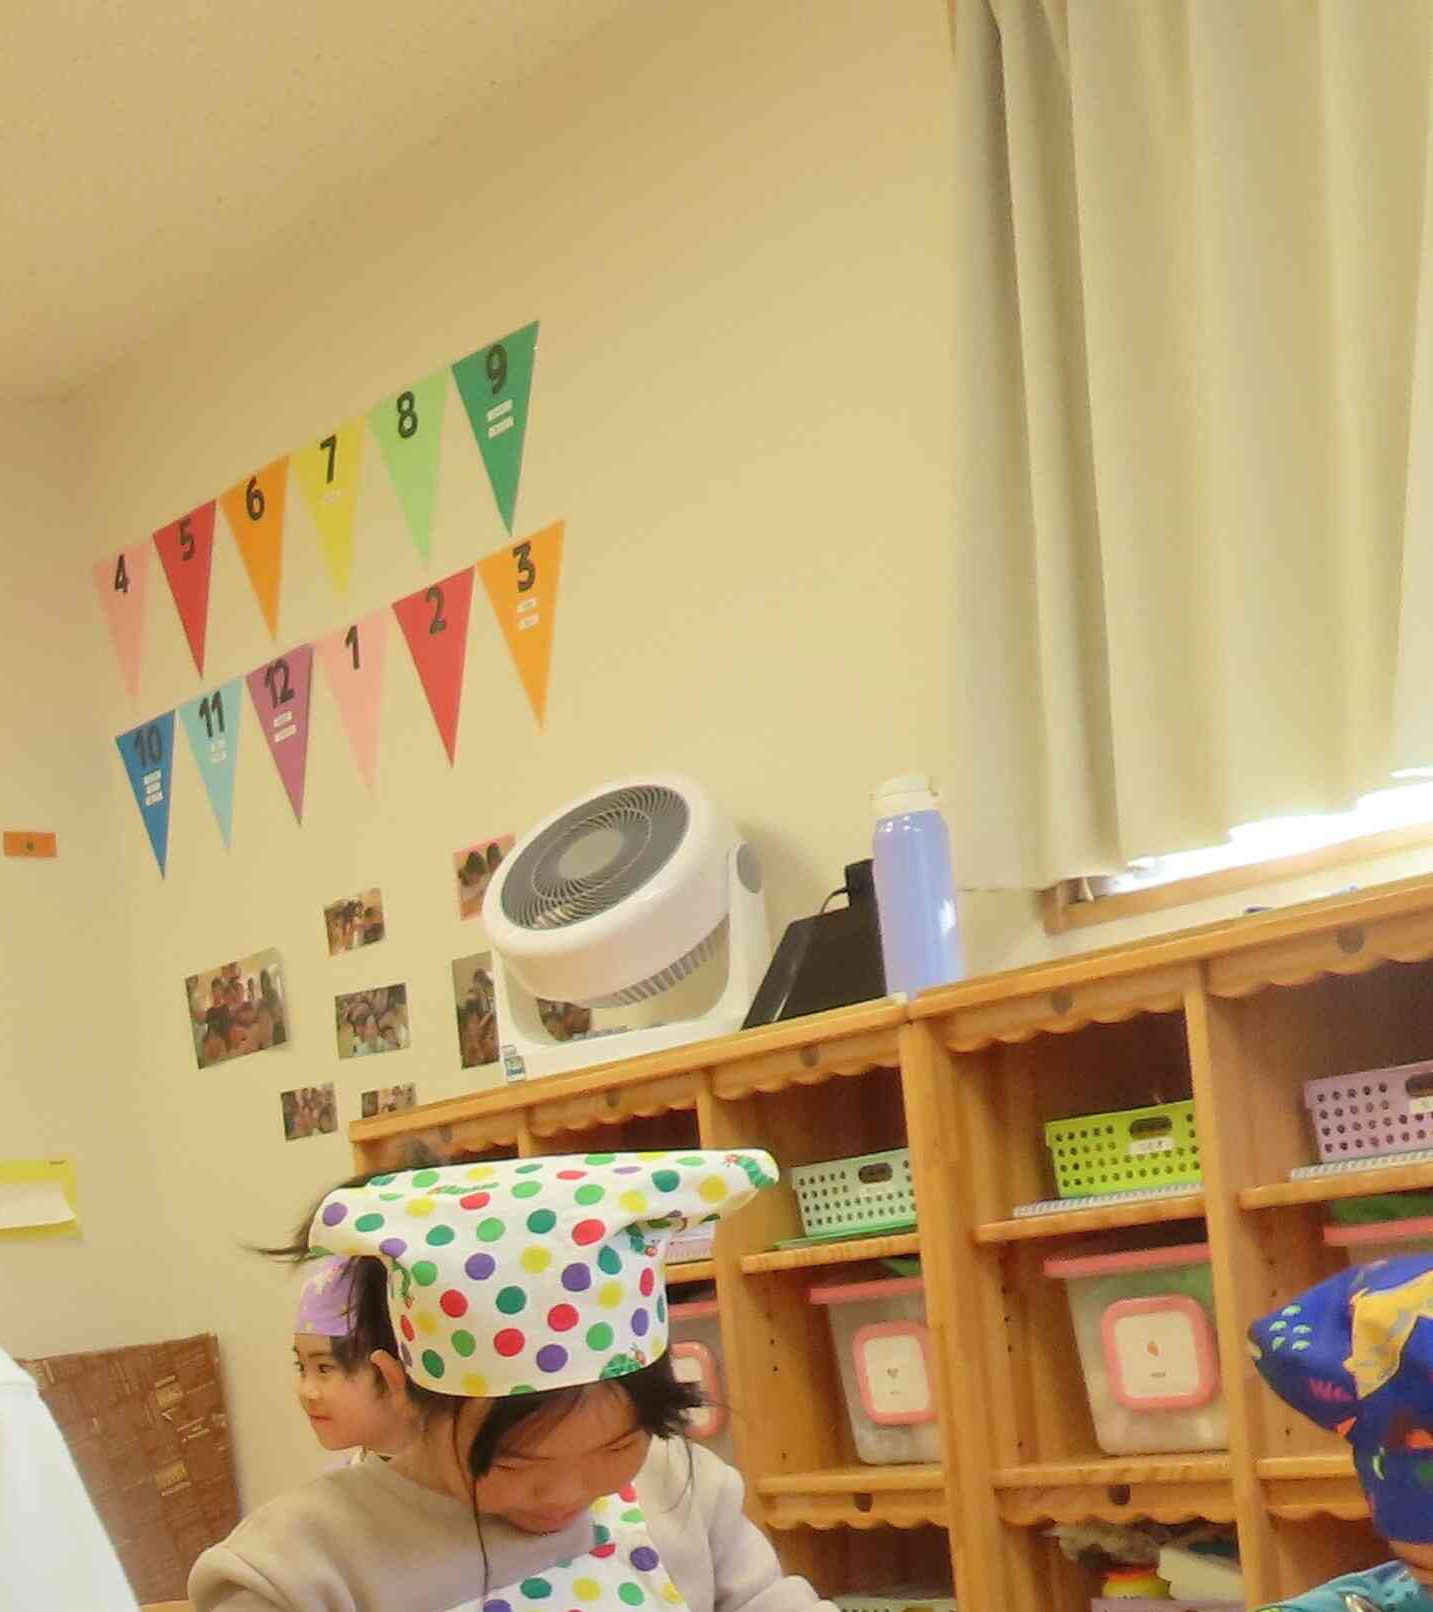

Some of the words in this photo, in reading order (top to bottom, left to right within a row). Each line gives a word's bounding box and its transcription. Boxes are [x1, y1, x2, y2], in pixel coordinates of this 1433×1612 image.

[486, 344, 508, 395] 9
[396, 391, 419, 438] 8
[319, 435, 338, 484] 7
[245, 476, 265, 521] 6
[179, 518, 196, 560] 5
[114, 553, 131, 595] 4
[512, 540, 536, 593] 3
[425, 585, 446, 635] 2
[344, 625, 361, 670] 1
[264, 658, 295, 710] 12
[198, 691, 226, 738] 11
[134, 726, 162, 768] 10
